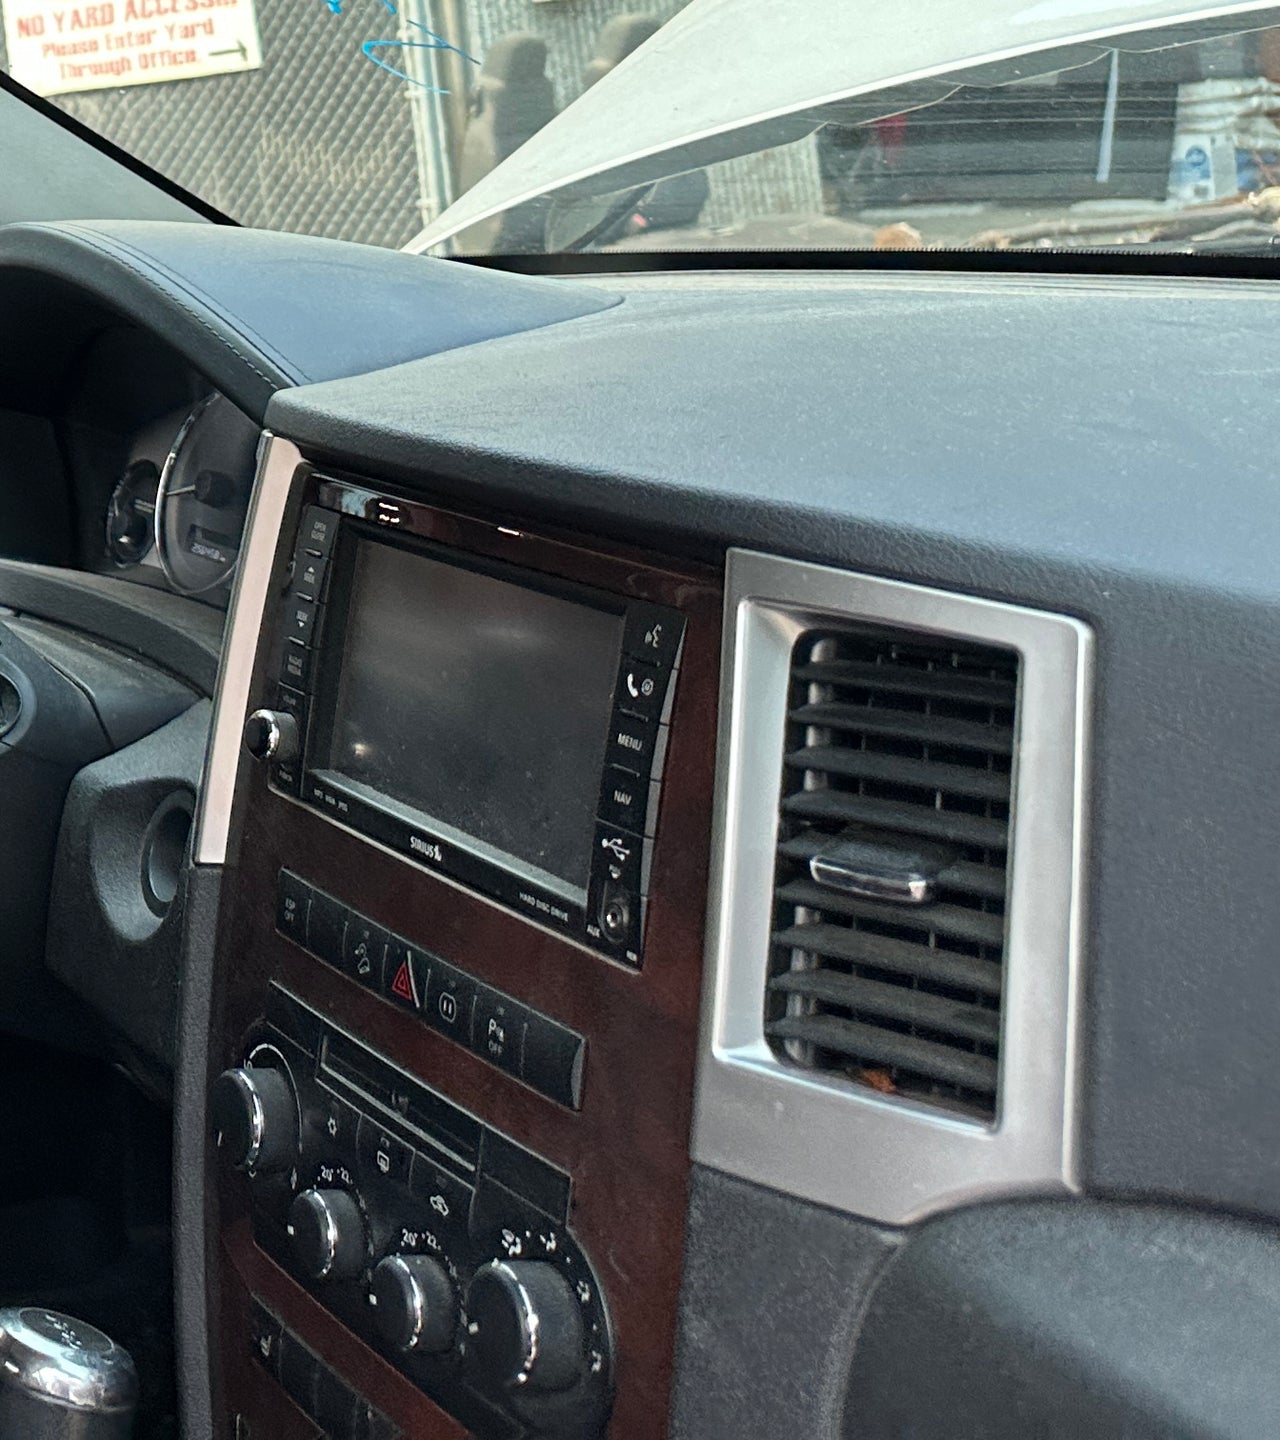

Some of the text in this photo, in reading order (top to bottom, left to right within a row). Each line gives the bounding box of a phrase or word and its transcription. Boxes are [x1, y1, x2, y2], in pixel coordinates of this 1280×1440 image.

[17, 16, 46, 39] NO
[50, 2, 115, 34] YARD
[42, 16, 215, 59] Please Enter Yard
[59, 56, 132, 80] Through
[617, 732, 643, 752] MENU
[613, 789, 632, 806] NAV
[410, 835, 434, 858] SIRIUS
